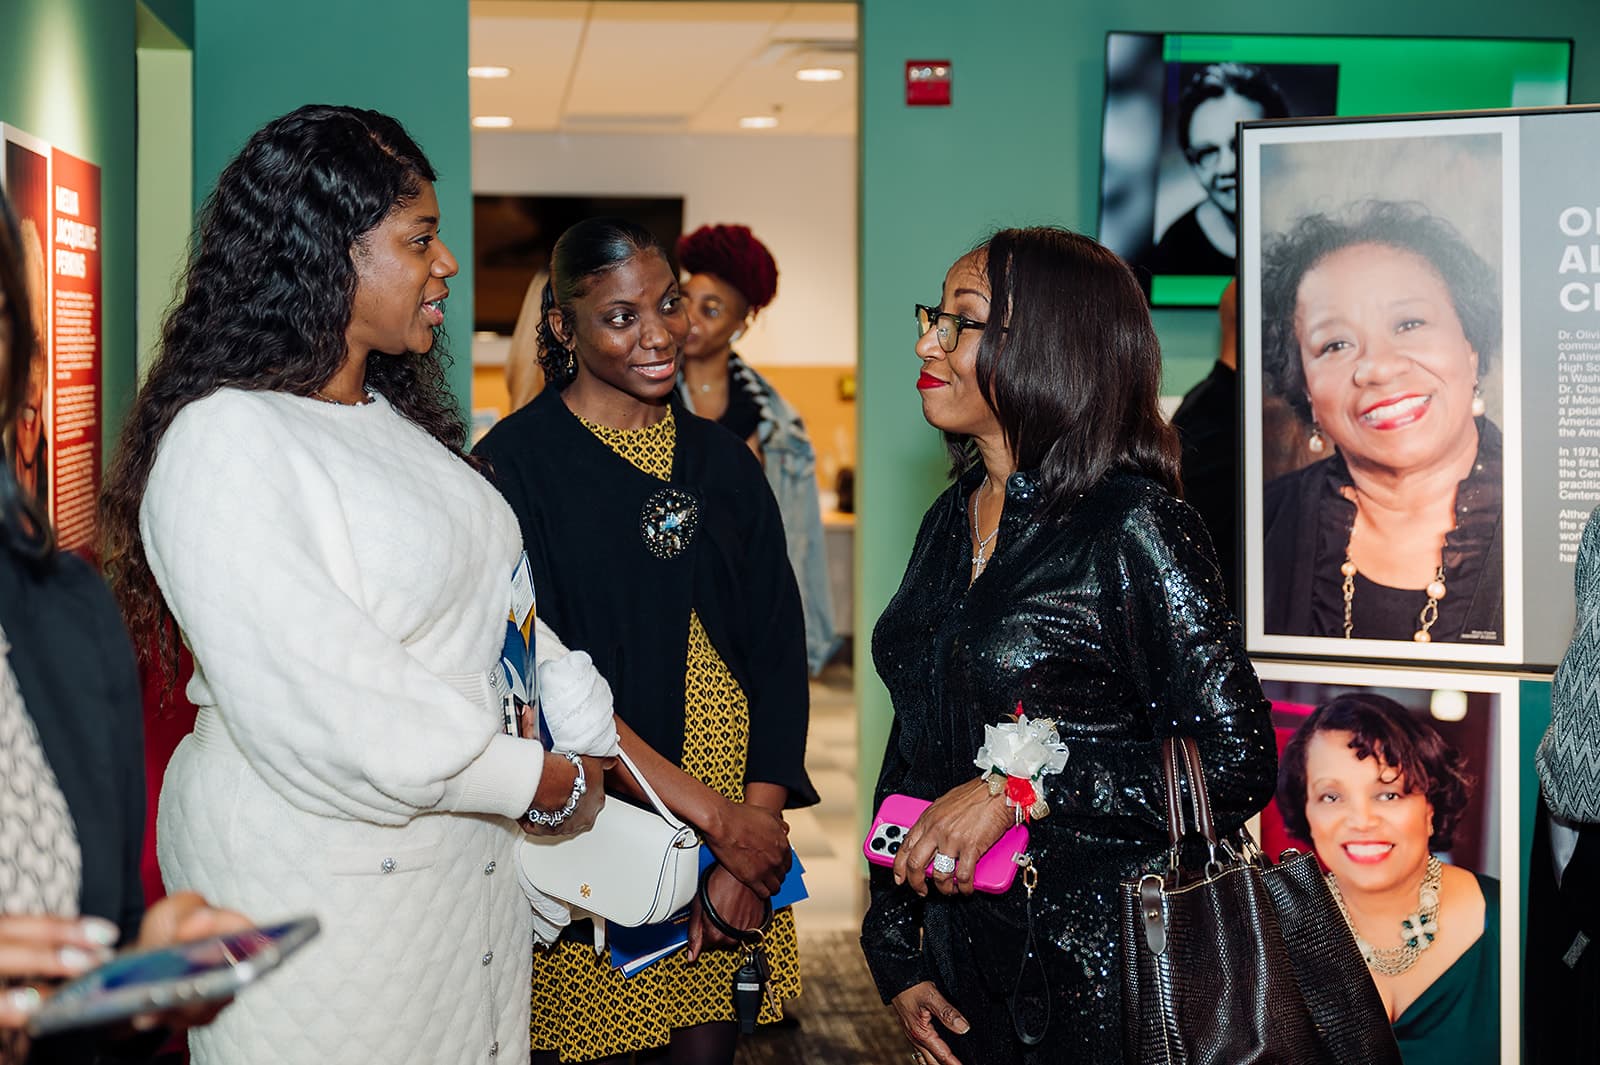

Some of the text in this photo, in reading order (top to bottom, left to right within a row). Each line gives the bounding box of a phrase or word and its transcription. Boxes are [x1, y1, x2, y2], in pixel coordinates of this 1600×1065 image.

[1559, 206, 1600, 236] O
[1559, 282, 1600, 312] C
[1558, 342, 1600, 351] commu
[1558, 353, 1567, 361] A
[1558, 363, 1583, 373] High
[1558, 373, 1568, 383] in
[1558, 384, 1573, 394] Dr.
[1558, 395, 1600, 405] of Medi
[1558, 408, 1566, 416] a
[1558, 428, 1576, 437] the
[1559, 447, 1569, 456] In
[1559, 458, 1599, 467] the first
[1559, 468, 1577, 478] the
[1559, 520, 1577, 530] the
